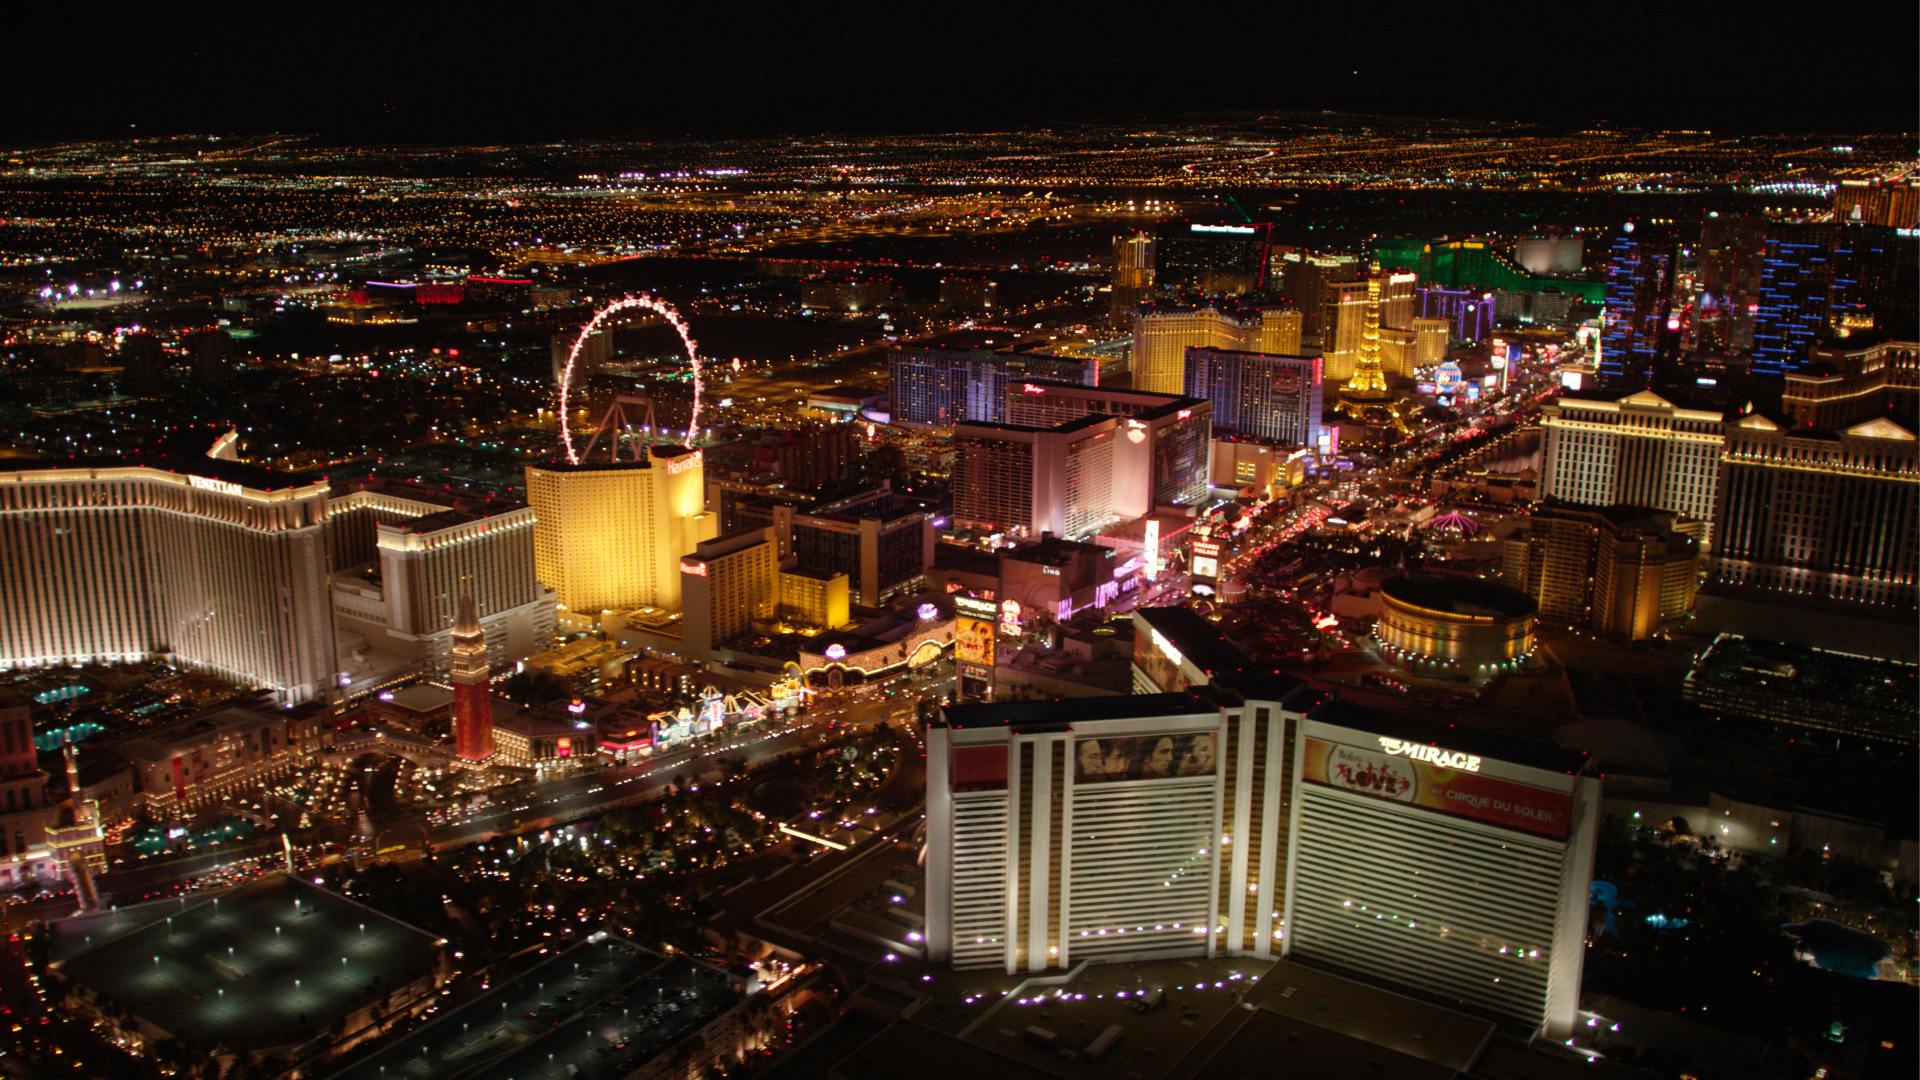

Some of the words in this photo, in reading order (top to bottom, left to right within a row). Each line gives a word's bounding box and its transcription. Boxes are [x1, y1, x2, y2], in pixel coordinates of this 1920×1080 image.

[189, 475, 242, 496] VENETIAN
[1379, 736, 1402, 752] THE
[1400, 741, 1481, 772] MIRAGE
[1346, 766, 1397, 794] LOVE
[1446, 789, 1490, 808] CIRQUE
[1492, 799, 1511, 812] DU
[1513, 804, 1555, 822] SOLEIL
